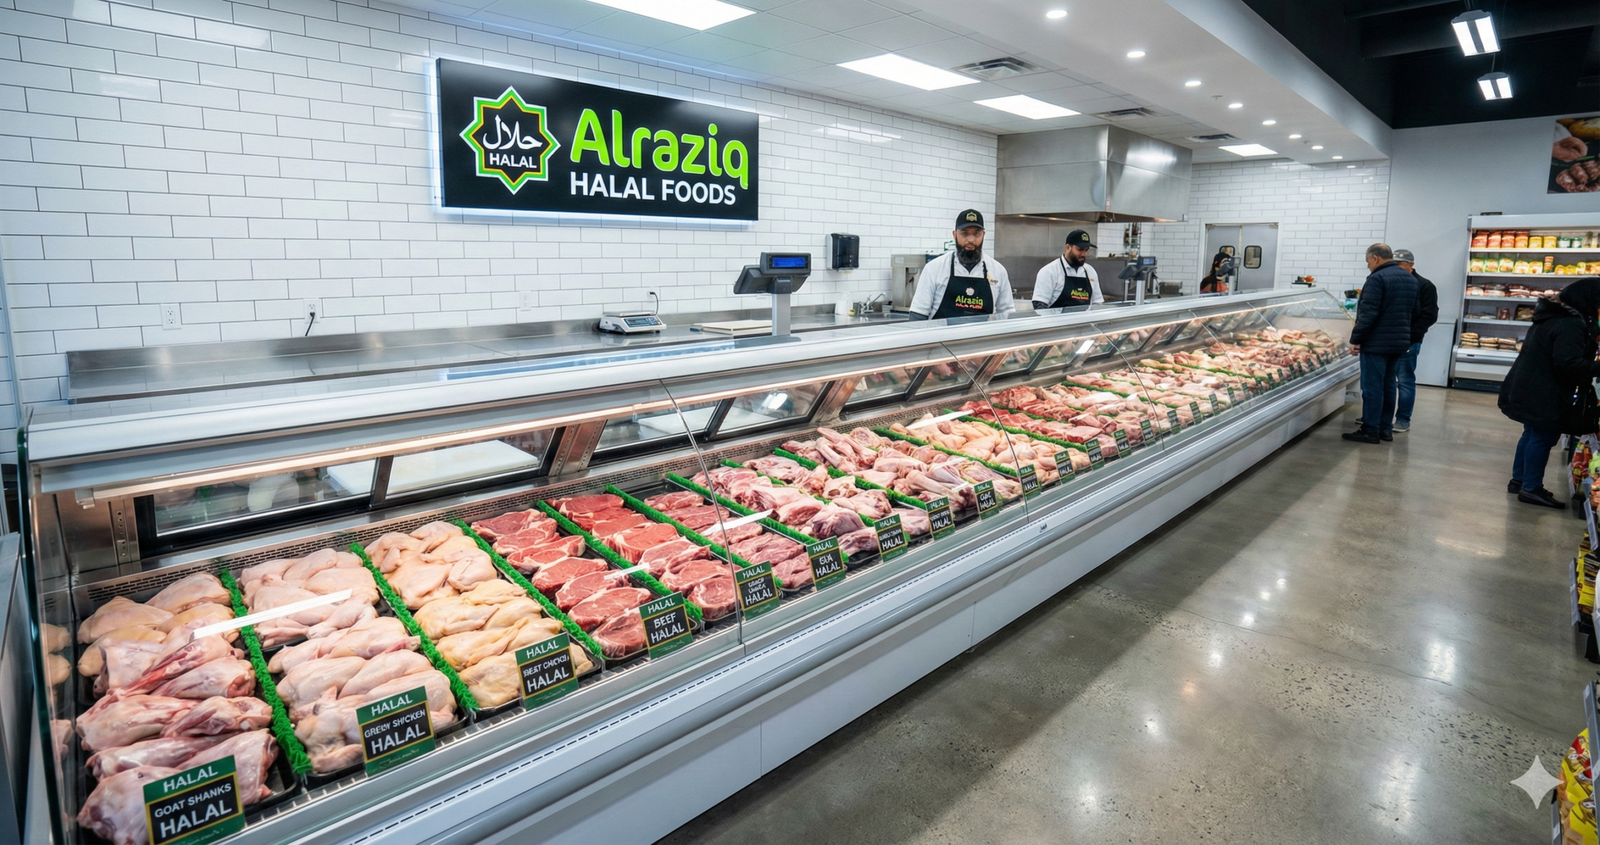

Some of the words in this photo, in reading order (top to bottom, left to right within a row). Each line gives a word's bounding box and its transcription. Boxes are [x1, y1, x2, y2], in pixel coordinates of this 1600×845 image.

[482, 114, 543, 151] حلال
[569, 108, 749, 190] Alraziq
[489, 152, 537, 169] HALAL
[569, 171, 655, 201] HALAL
[661, 179, 737, 206] FOODS
[812, 540, 834, 554] HALAL
[742, 565, 766, 579] HALAL
[816, 562, 841, 578] HALAL
[647, 598, 676, 614] HALAL
[745, 588, 773, 606] HALAL
[653, 612, 676, 629] BEEF
[650, 622, 685, 644] HALAL
[526, 640, 560, 659] HALAL
[526, 666, 570, 693] HALAL
[371, 694, 414, 717] HALAL
[371, 724, 426, 755] HALAL
[163, 766, 218, 793] HALAL
[154, 799, 186, 818] GOAT
[187, 783, 232, 806] SHANKS
[160, 800, 232, 838] HALAL
